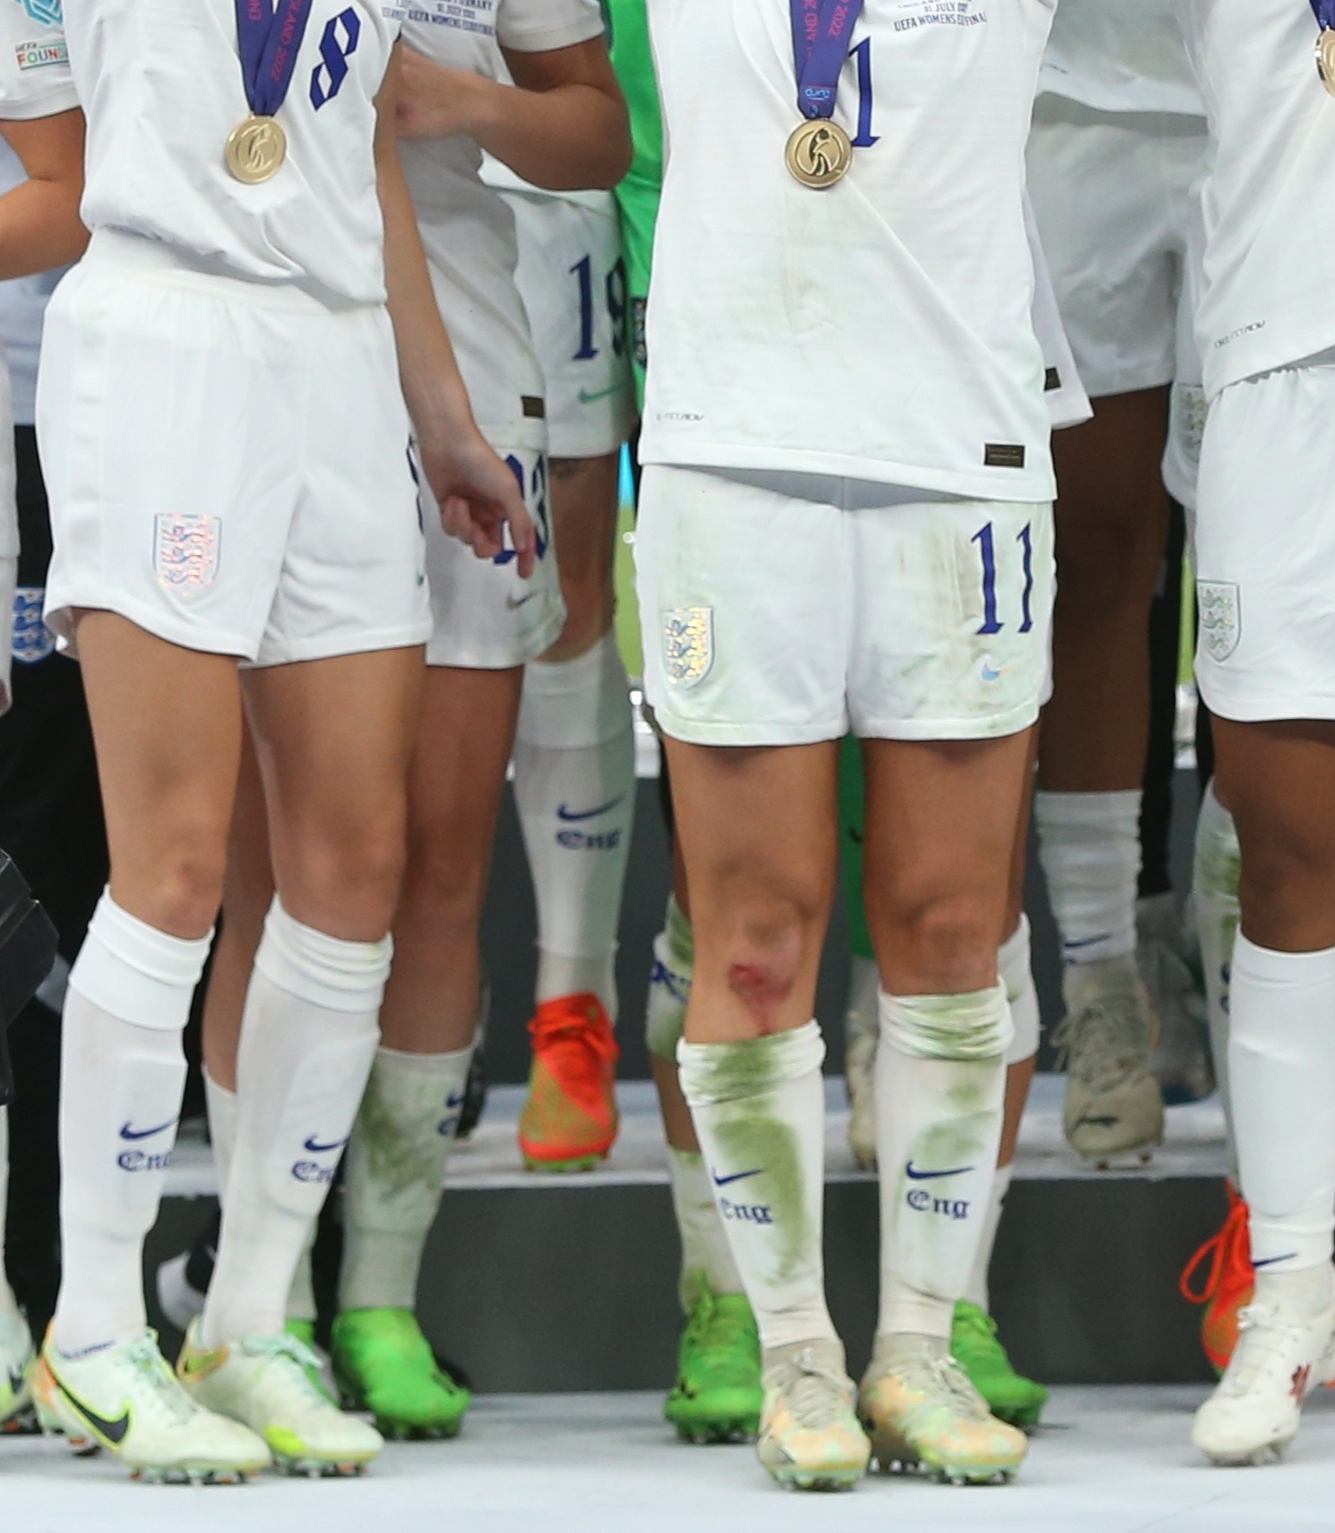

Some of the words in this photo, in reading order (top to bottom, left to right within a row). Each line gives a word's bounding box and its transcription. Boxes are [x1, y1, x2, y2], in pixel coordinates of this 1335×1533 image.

[828, 4, 848, 37] 2022
[893, 16, 918, 32] UEFA
[917, 14, 956, 26] WOMENS
[310, 7, 361, 112] 8
[970, 521, 1036, 635] 11
[907, 1189, 972, 1220] Eng
